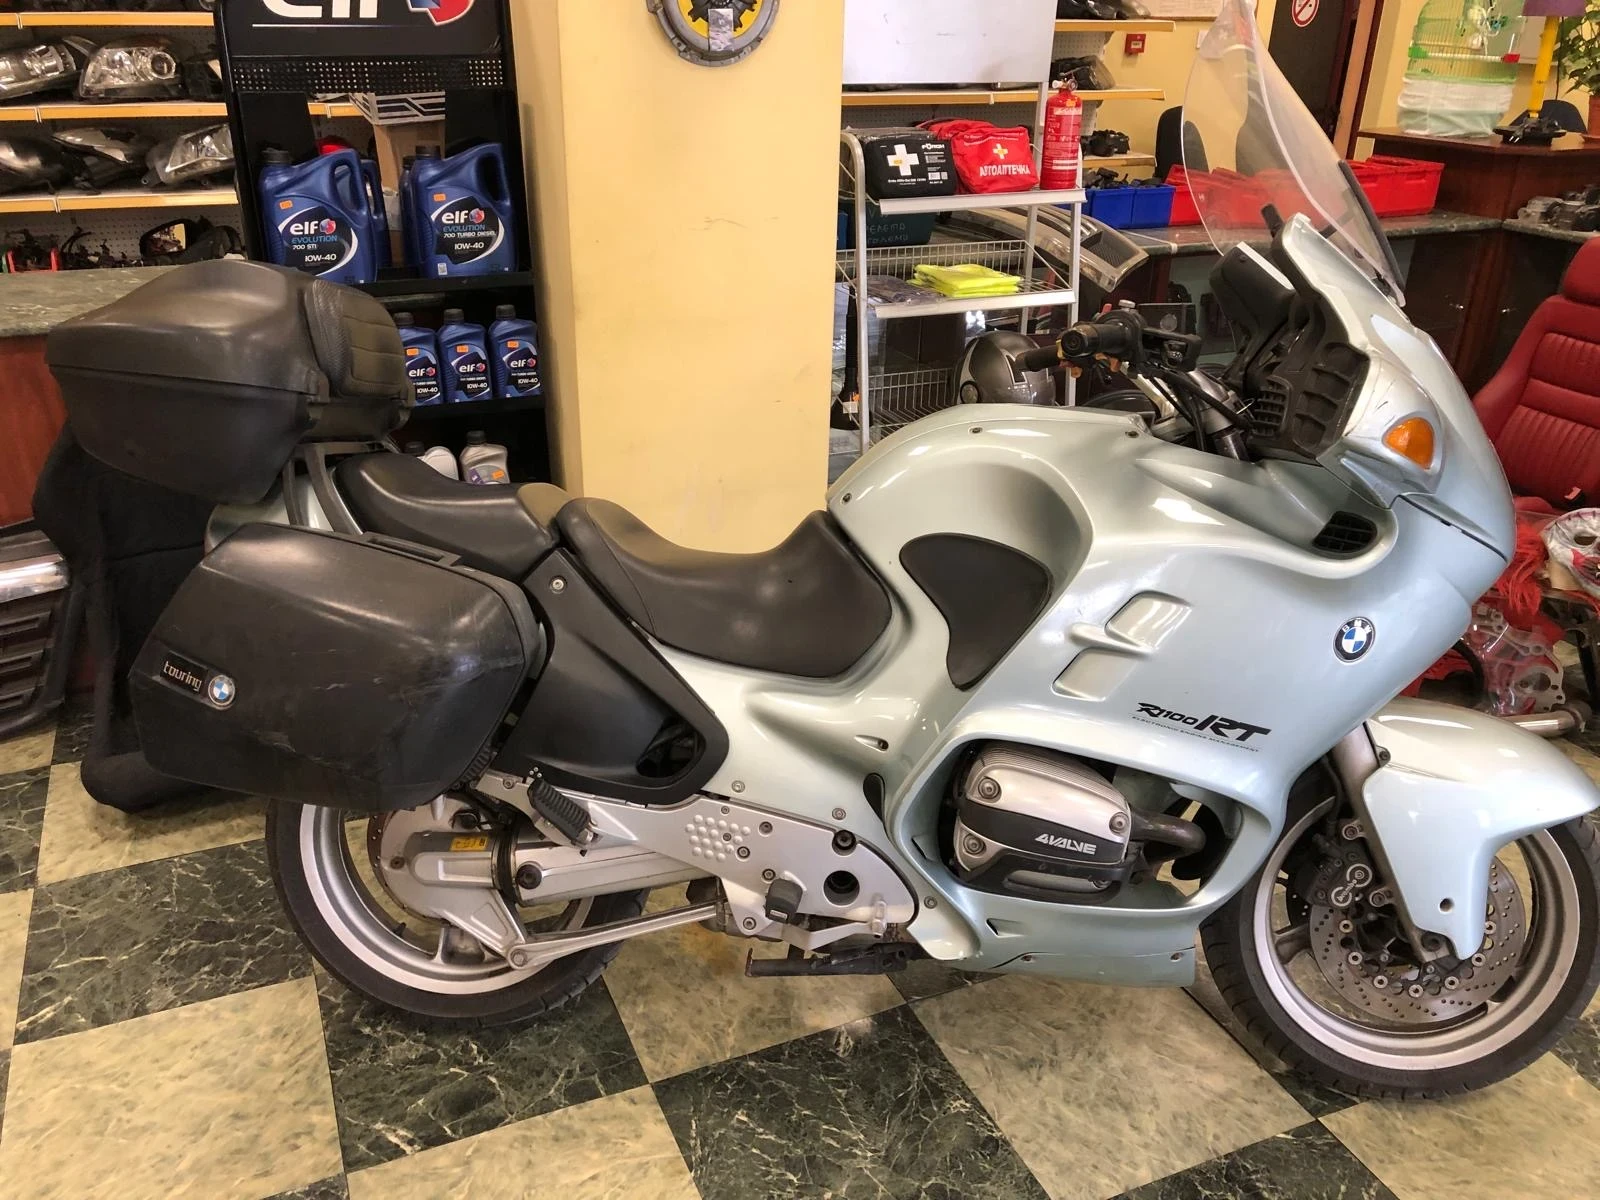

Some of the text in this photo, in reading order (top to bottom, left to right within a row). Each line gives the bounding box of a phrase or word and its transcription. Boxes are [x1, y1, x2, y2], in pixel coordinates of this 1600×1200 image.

[980, 164, 1031, 177] АВТОАПТЕЧКА
[441, 210, 468, 224] elf
[290, 221, 318, 235] elf
[443, 224, 486, 233] EVOLUTION
[291, 235, 338, 244] EVOLUTION
[454, 241, 485, 251] 10W-40
[304, 253, 337, 263] 10W-40
[459, 363, 476, 373] elf
[510, 359, 527, 368] elf
[408, 368, 426, 377] elf
[416, 386, 439, 394] 10W-40
[163, 661, 202, 692] touring
